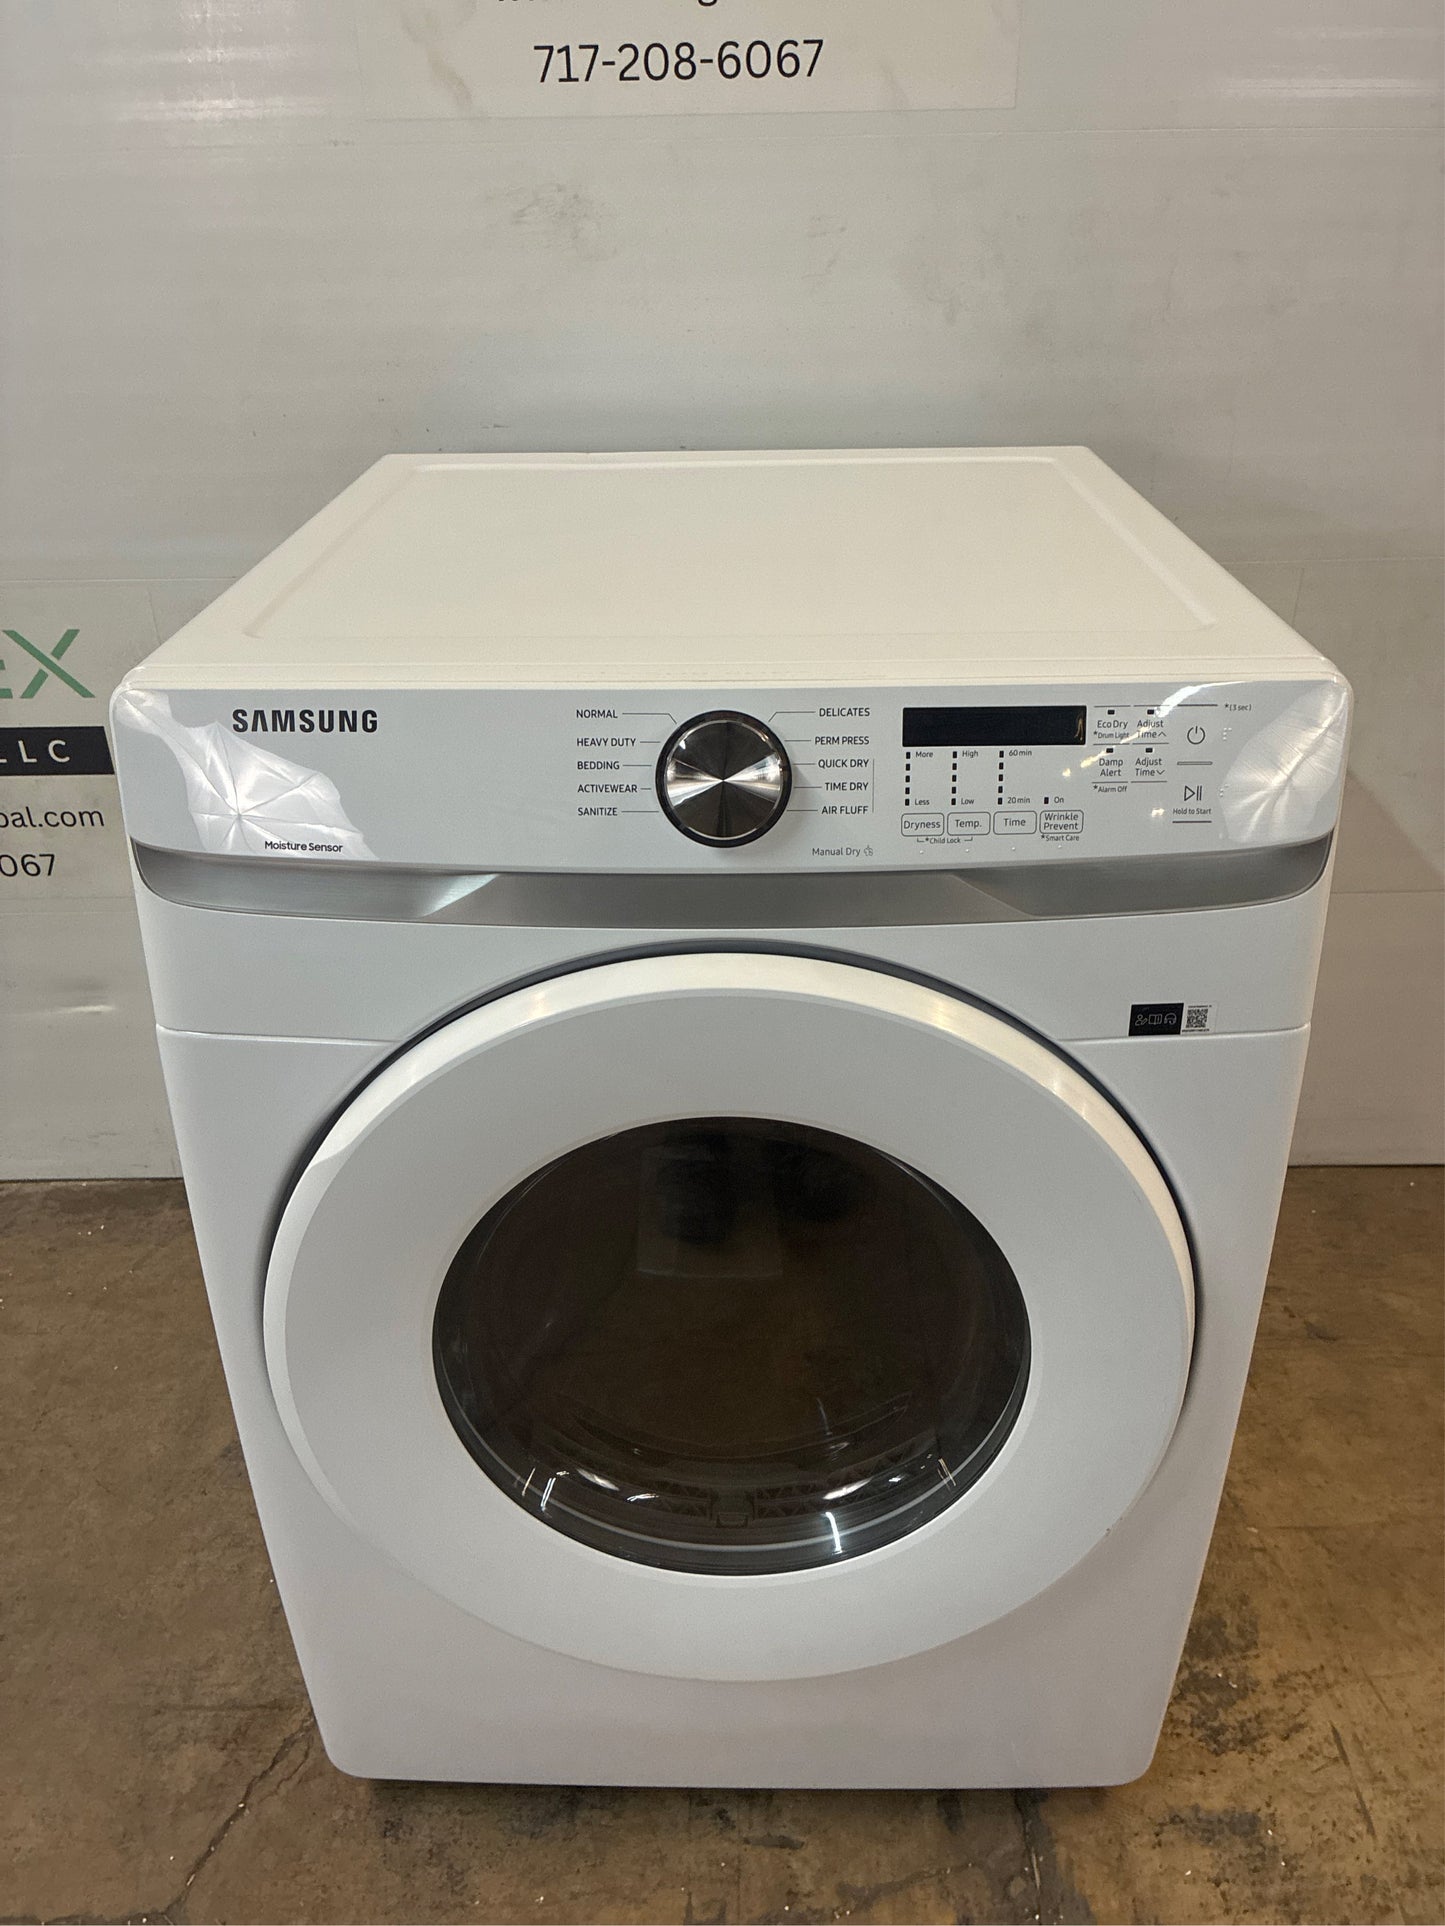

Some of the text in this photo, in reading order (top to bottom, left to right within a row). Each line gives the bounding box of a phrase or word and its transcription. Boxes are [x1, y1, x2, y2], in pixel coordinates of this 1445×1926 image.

[532, 38, 825, 84] 717-208-6067
[576, 709, 618, 719] NORMAL
[819, 707, 870, 717] DELICATES
[231, 709, 379, 733] SAMSUNG
[1097, 720, 1128, 729] Eco Dry
[1137, 720, 1164, 728] Adjust
[1115, 731, 1130, 739] Light
[577, 737, 636, 747] HEAVY DUTY
[815, 735, 870, 746] PERM PRESS
[962, 750, 979, 759] High
[1009, 749, 1019, 757] 60
[577, 761, 620, 770] BEDDING
[818, 758, 869, 769] QUICK DRY
[1099, 758, 1124, 767] Damp
[1135, 757, 1163, 767] Adjust
[1100, 769, 1122, 777] Alert
[1136, 769, 1156, 777] Time
[577, 783, 638, 793] ACTIVEWEAR
[825, 782, 869, 791] TIME DRY
[1117, 785, 1128, 793] Off
[914, 798, 930, 806] Less
[961, 797, 975, 805] Low
[1007, 796, 1018, 804] 20
[1053, 796, 1065, 804] On
[577, 807, 618, 817] SANITIZE
[821, 805, 869, 815] AIR FLUFF
[1044, 813, 1079, 821] Wrinkle
[903, 819, 941, 830] Dryness
[955, 819, 983, 829] Temp.
[1004, 818, 1027, 827] Time
[1043, 822, 1079, 831] Prevent
[264, 840, 343, 852] Moisture Sensor
[812, 847, 861, 857] Manual Dry
